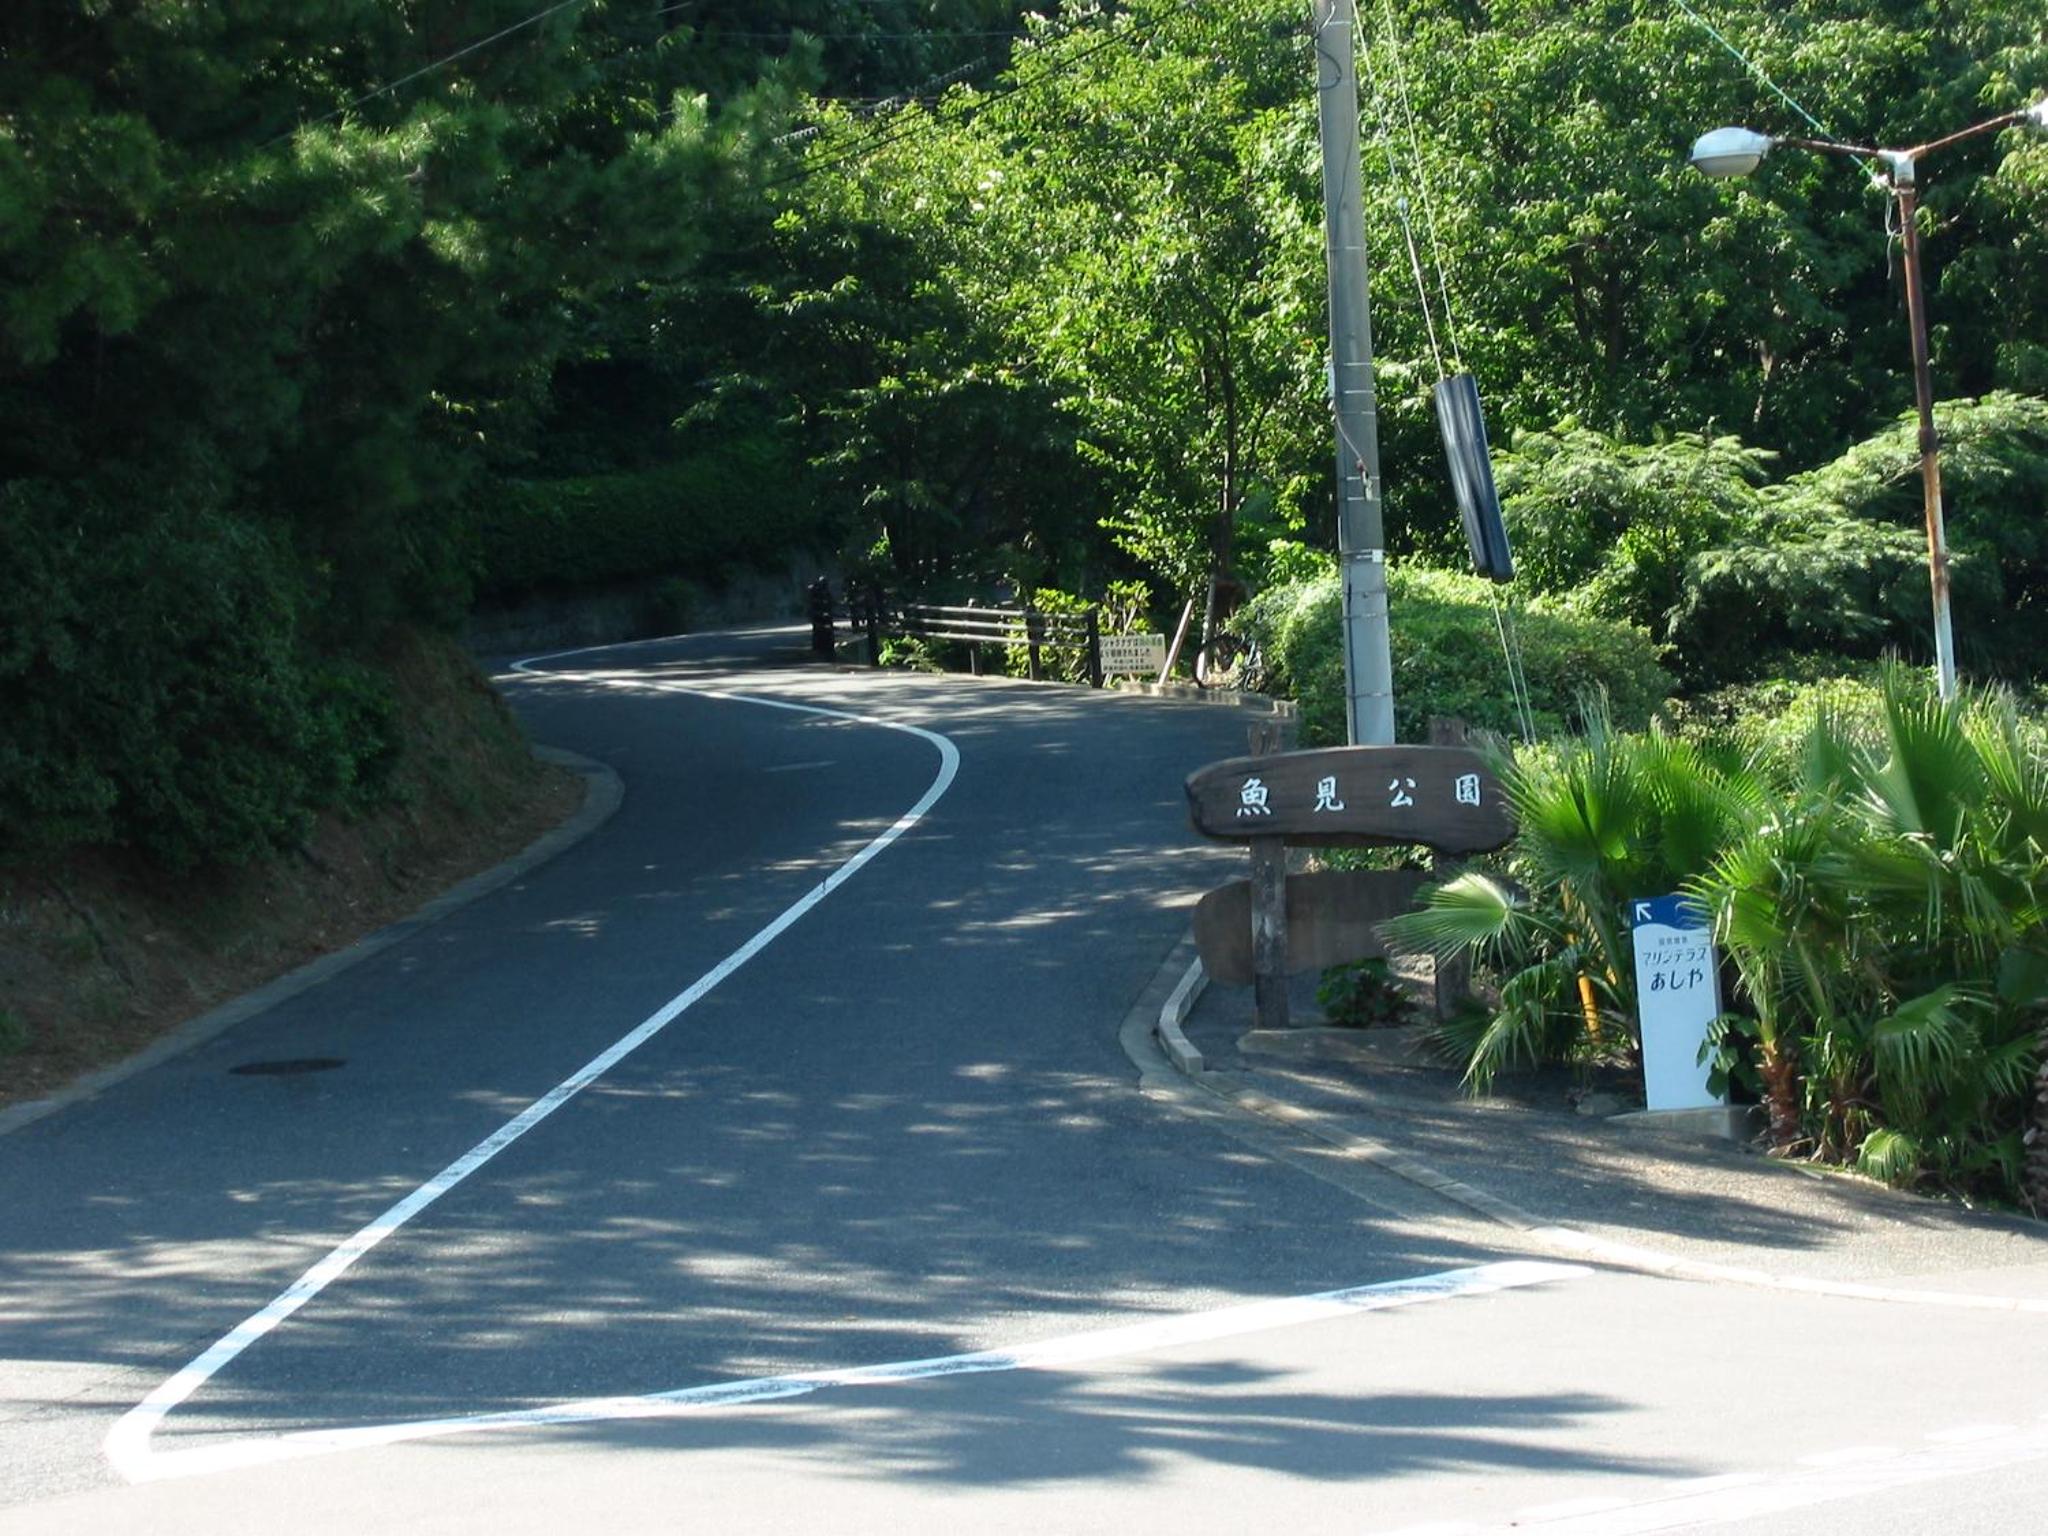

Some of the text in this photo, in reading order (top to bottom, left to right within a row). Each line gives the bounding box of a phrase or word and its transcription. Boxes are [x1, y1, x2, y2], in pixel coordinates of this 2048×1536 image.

[1236, 773, 1481, 817] 魚見公園
[1643, 947, 1706, 967] マリンテラス
[1651, 968, 1704, 991] あしや
